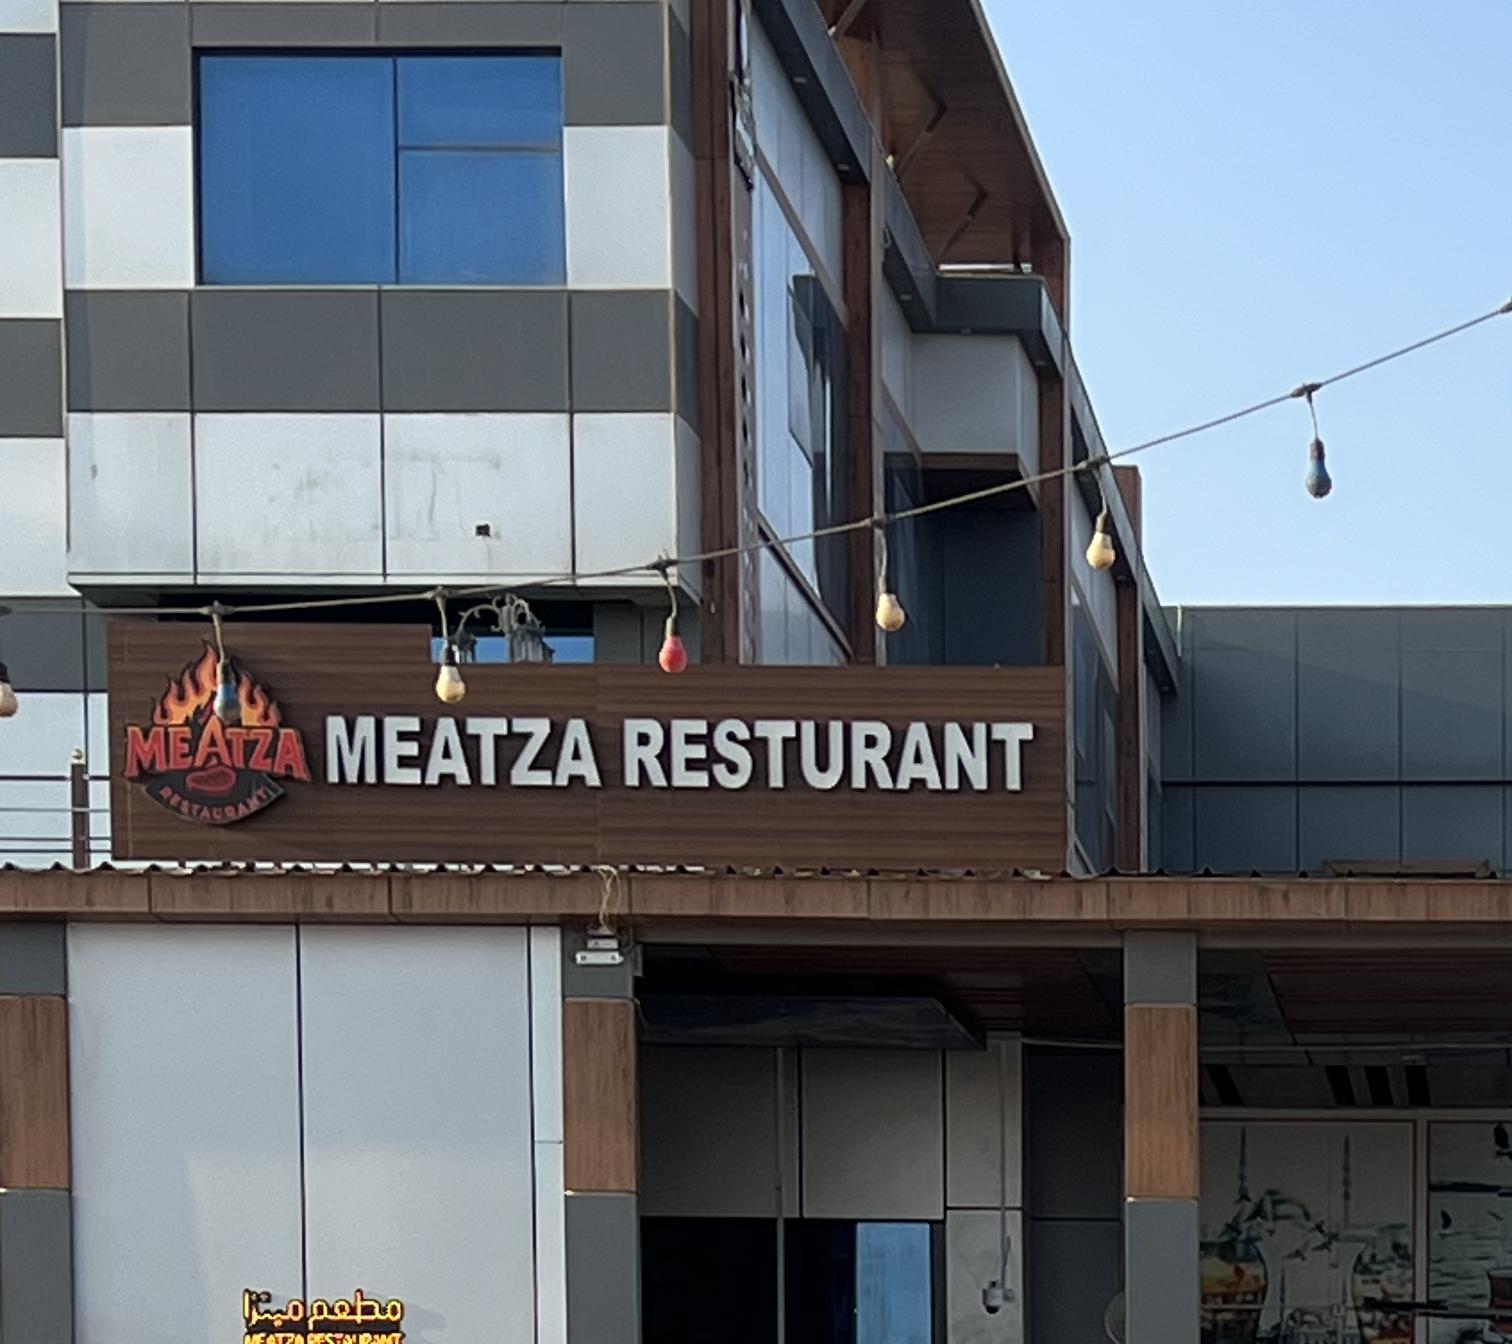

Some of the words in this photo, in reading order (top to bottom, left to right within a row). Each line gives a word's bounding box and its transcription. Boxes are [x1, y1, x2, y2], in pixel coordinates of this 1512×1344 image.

[123, 714, 311, 782] MEATZA
[325, 715, 601, 789] MEATZA
[623, 718, 1035, 792] RESTURANT
[159, 785, 269, 820] RESTAURANT
[307, 1288, 403, 1331] مطعم
